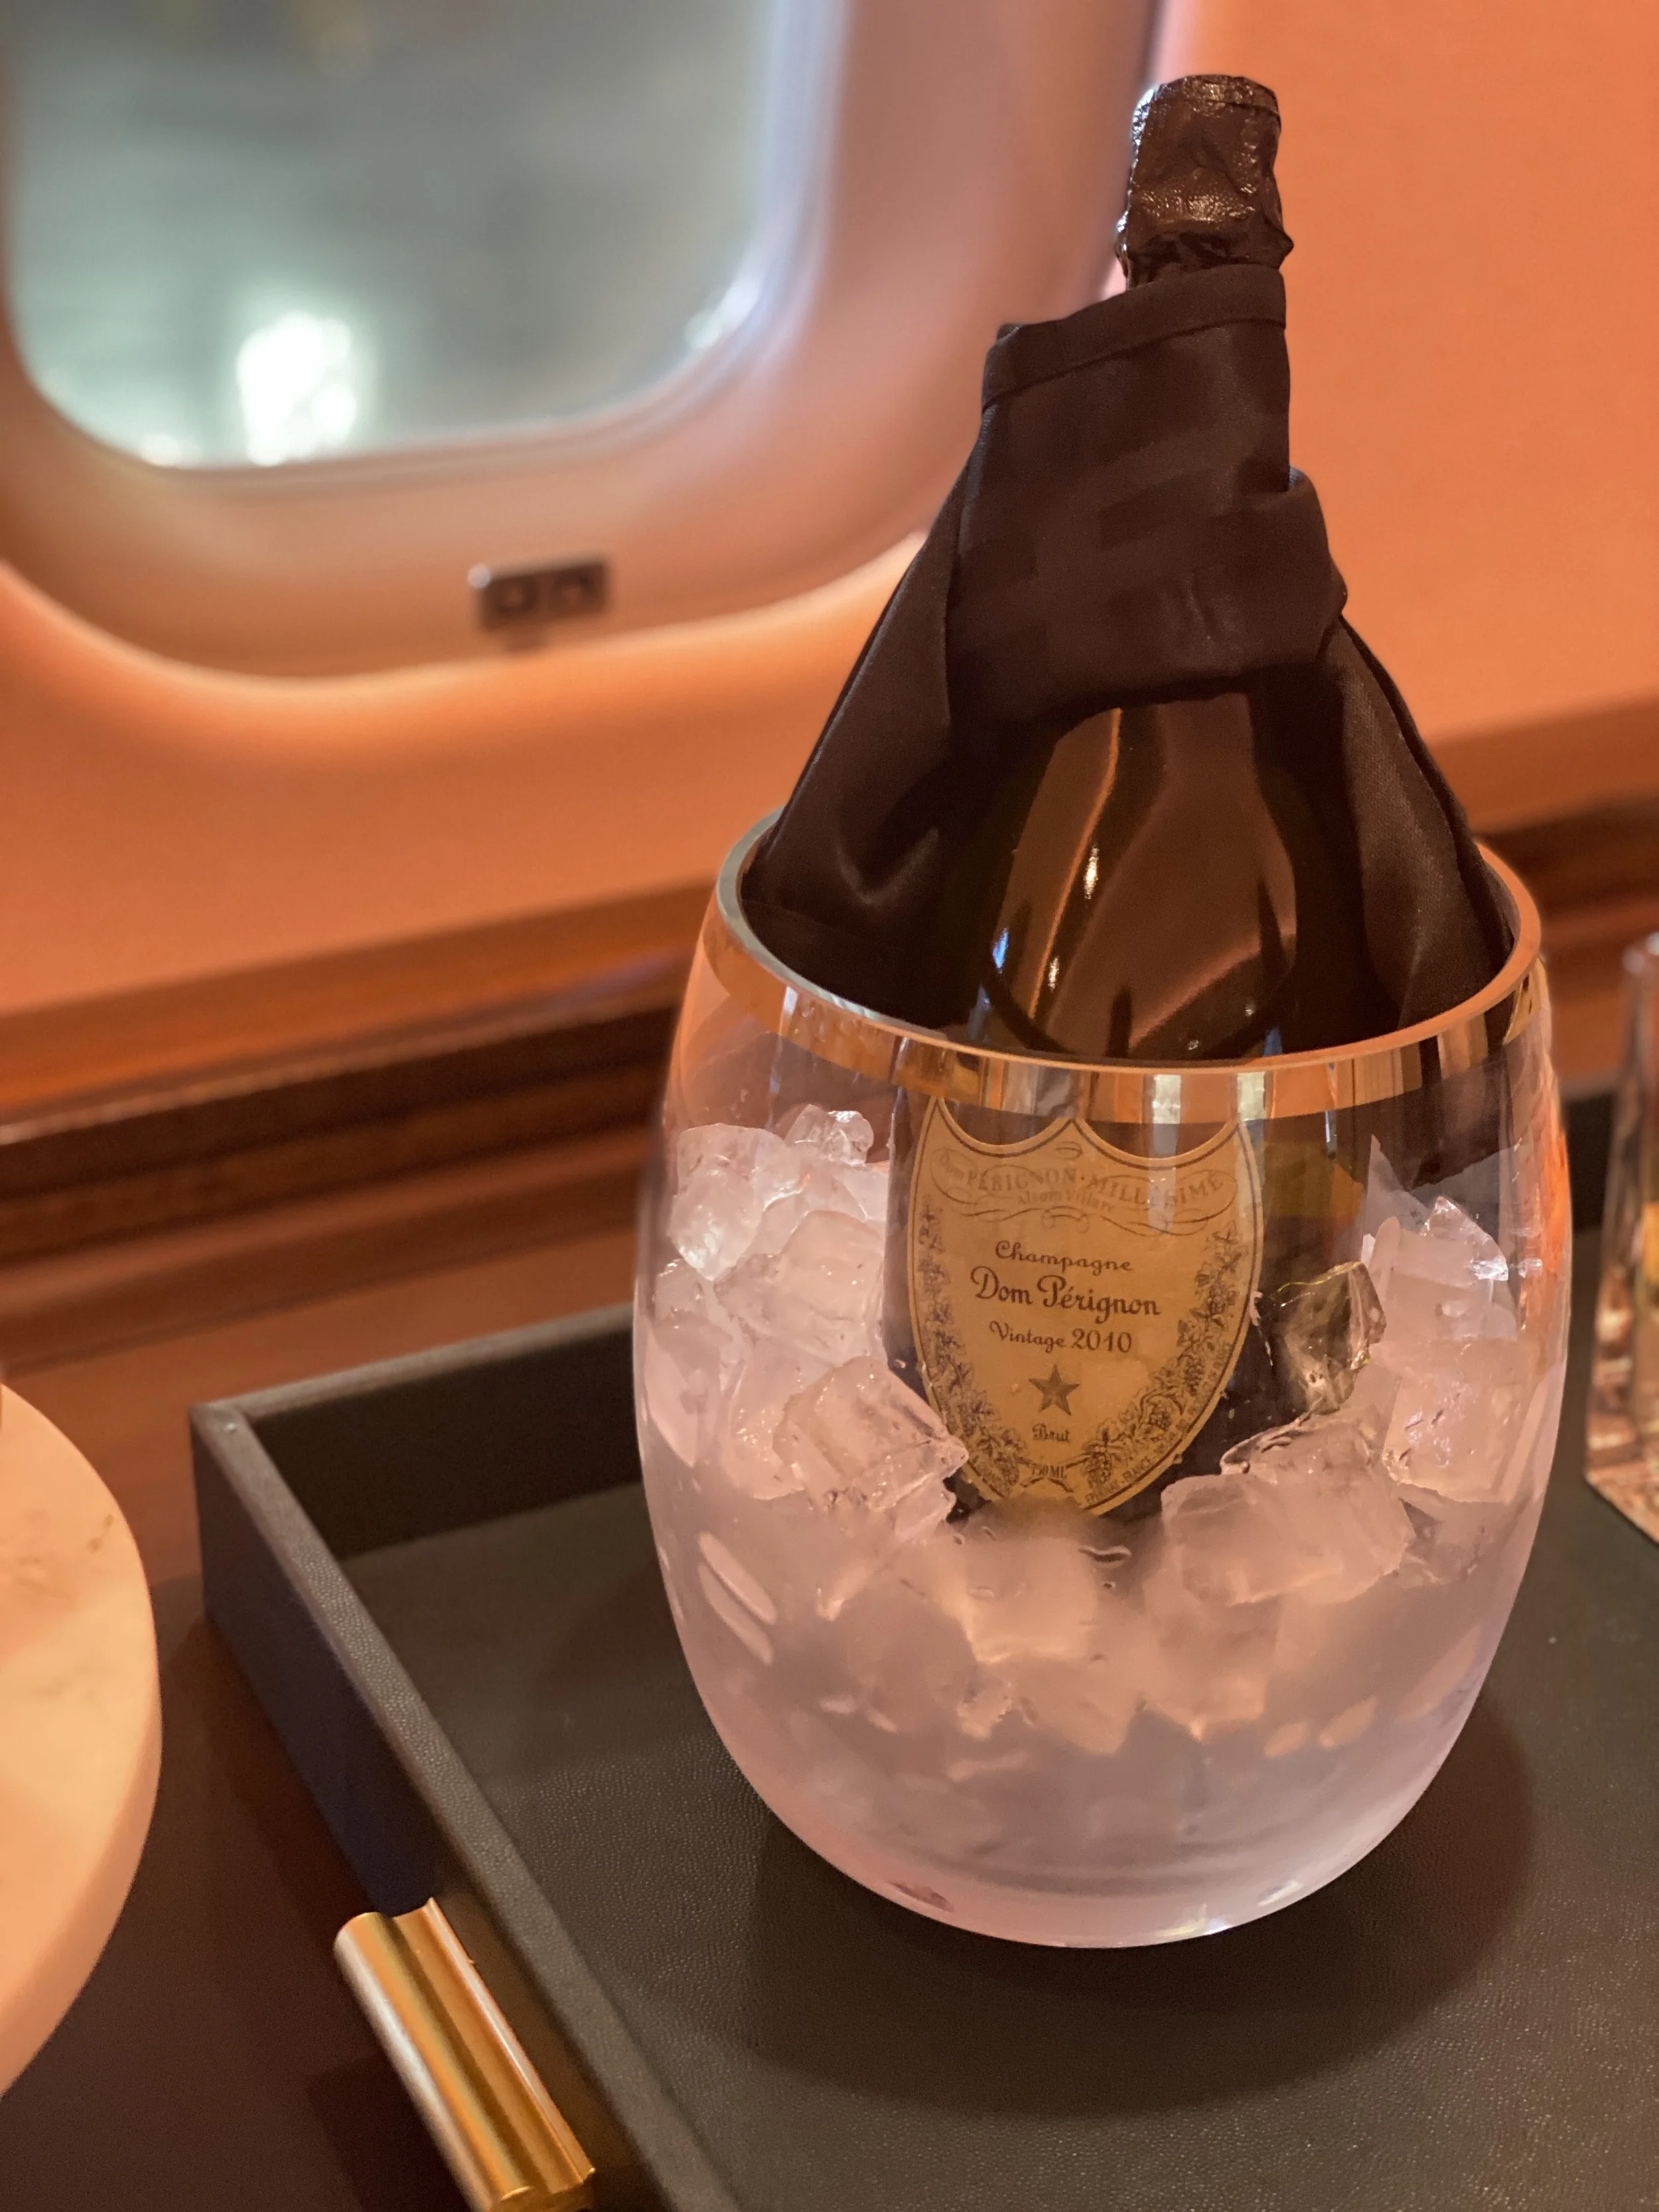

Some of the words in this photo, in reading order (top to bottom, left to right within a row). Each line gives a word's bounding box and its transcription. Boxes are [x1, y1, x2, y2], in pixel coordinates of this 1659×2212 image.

[995, 1240, 1134, 1276] Champagne
[970, 1265, 1033, 1305] Dom
[1036, 1274, 1162, 1325] Pérignon
[989, 1321, 1067, 1355] Vintage
[1072, 1327, 1132, 1354] 2010
[1032, 1423, 1070, 1443] Brut
